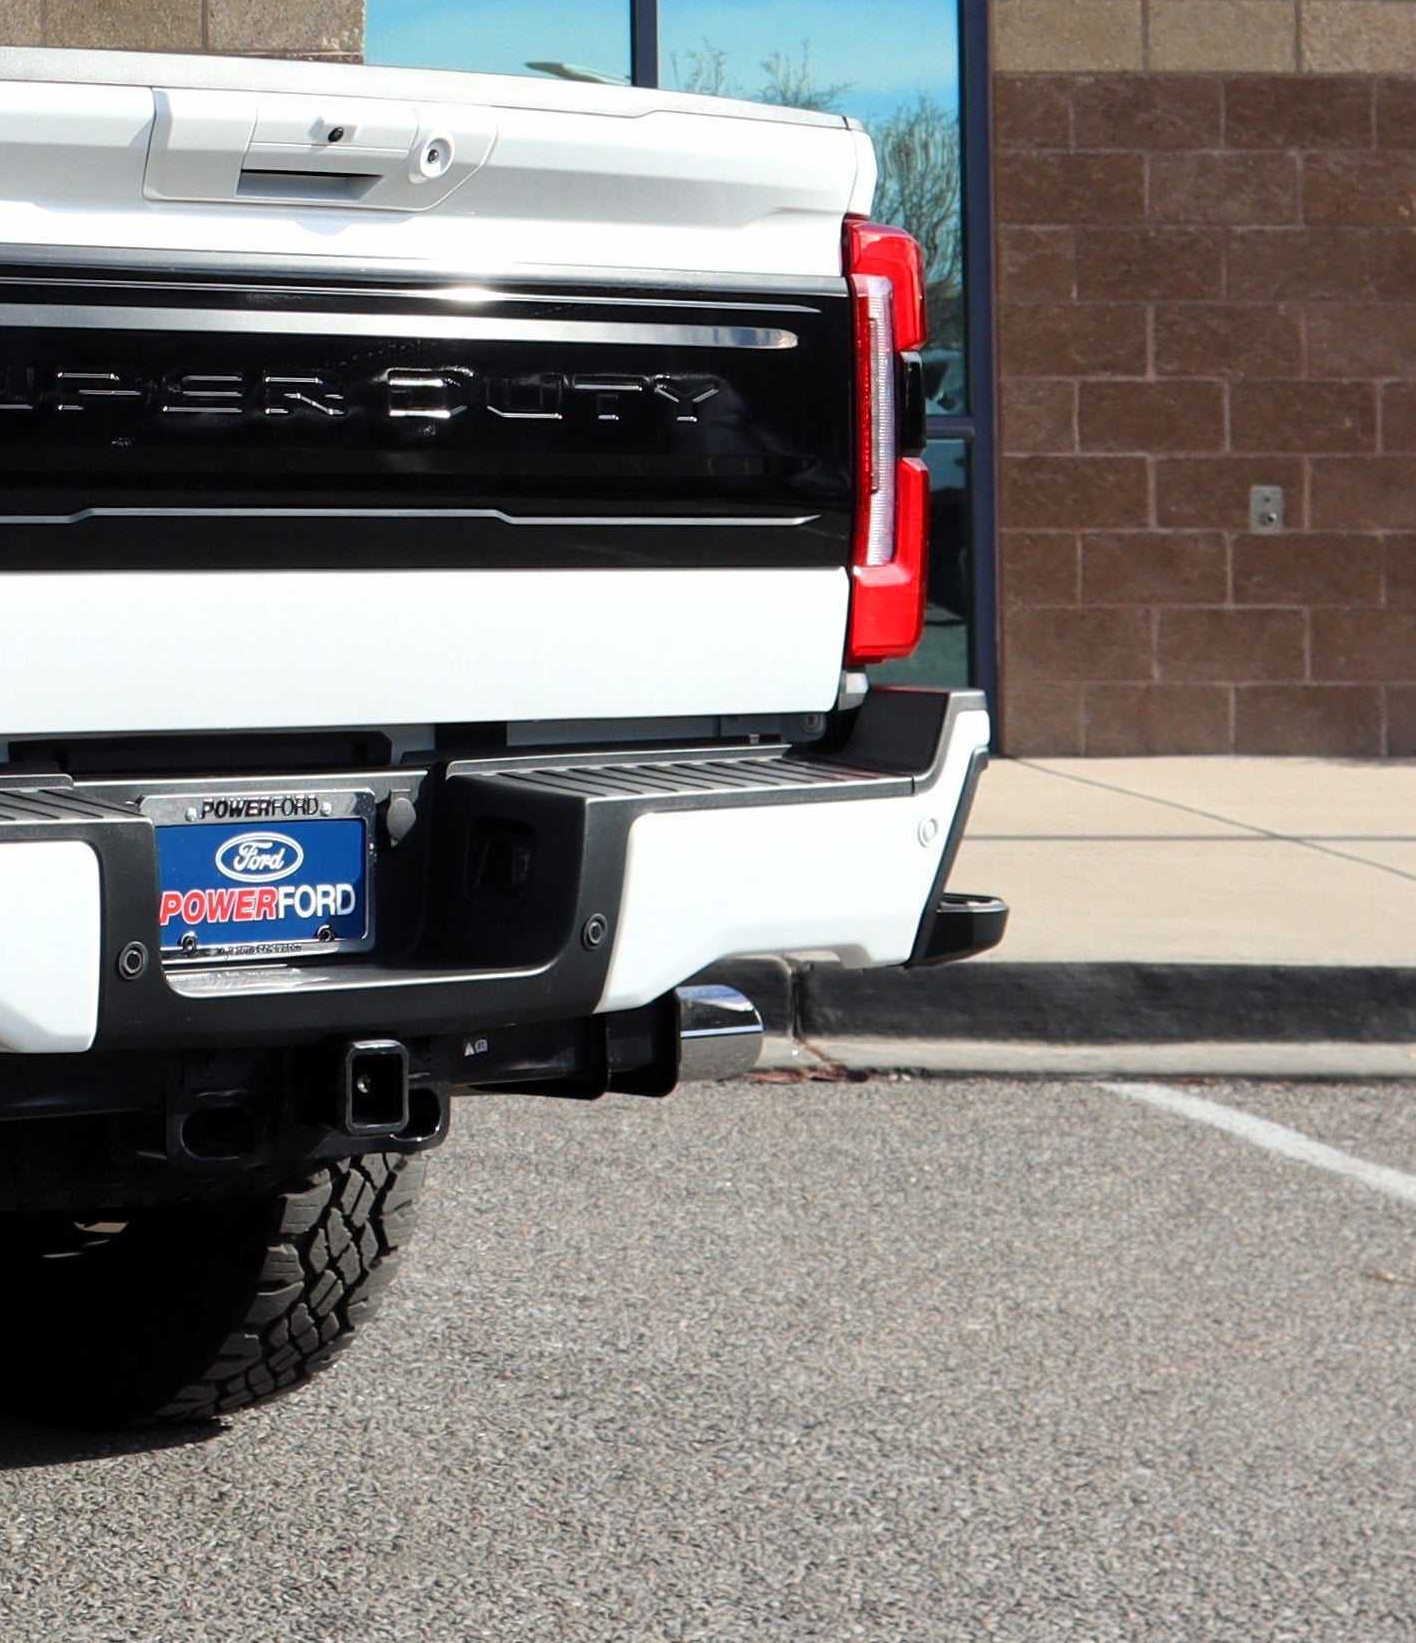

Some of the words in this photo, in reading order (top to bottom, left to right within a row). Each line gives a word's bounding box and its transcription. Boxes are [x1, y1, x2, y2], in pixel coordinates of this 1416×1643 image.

[385, 368, 723, 422] DUTY
[200, 794, 319, 819] POWERFORD
[233, 841, 286, 871] Ford
[159, 883, 356, 926] POWERFORD
